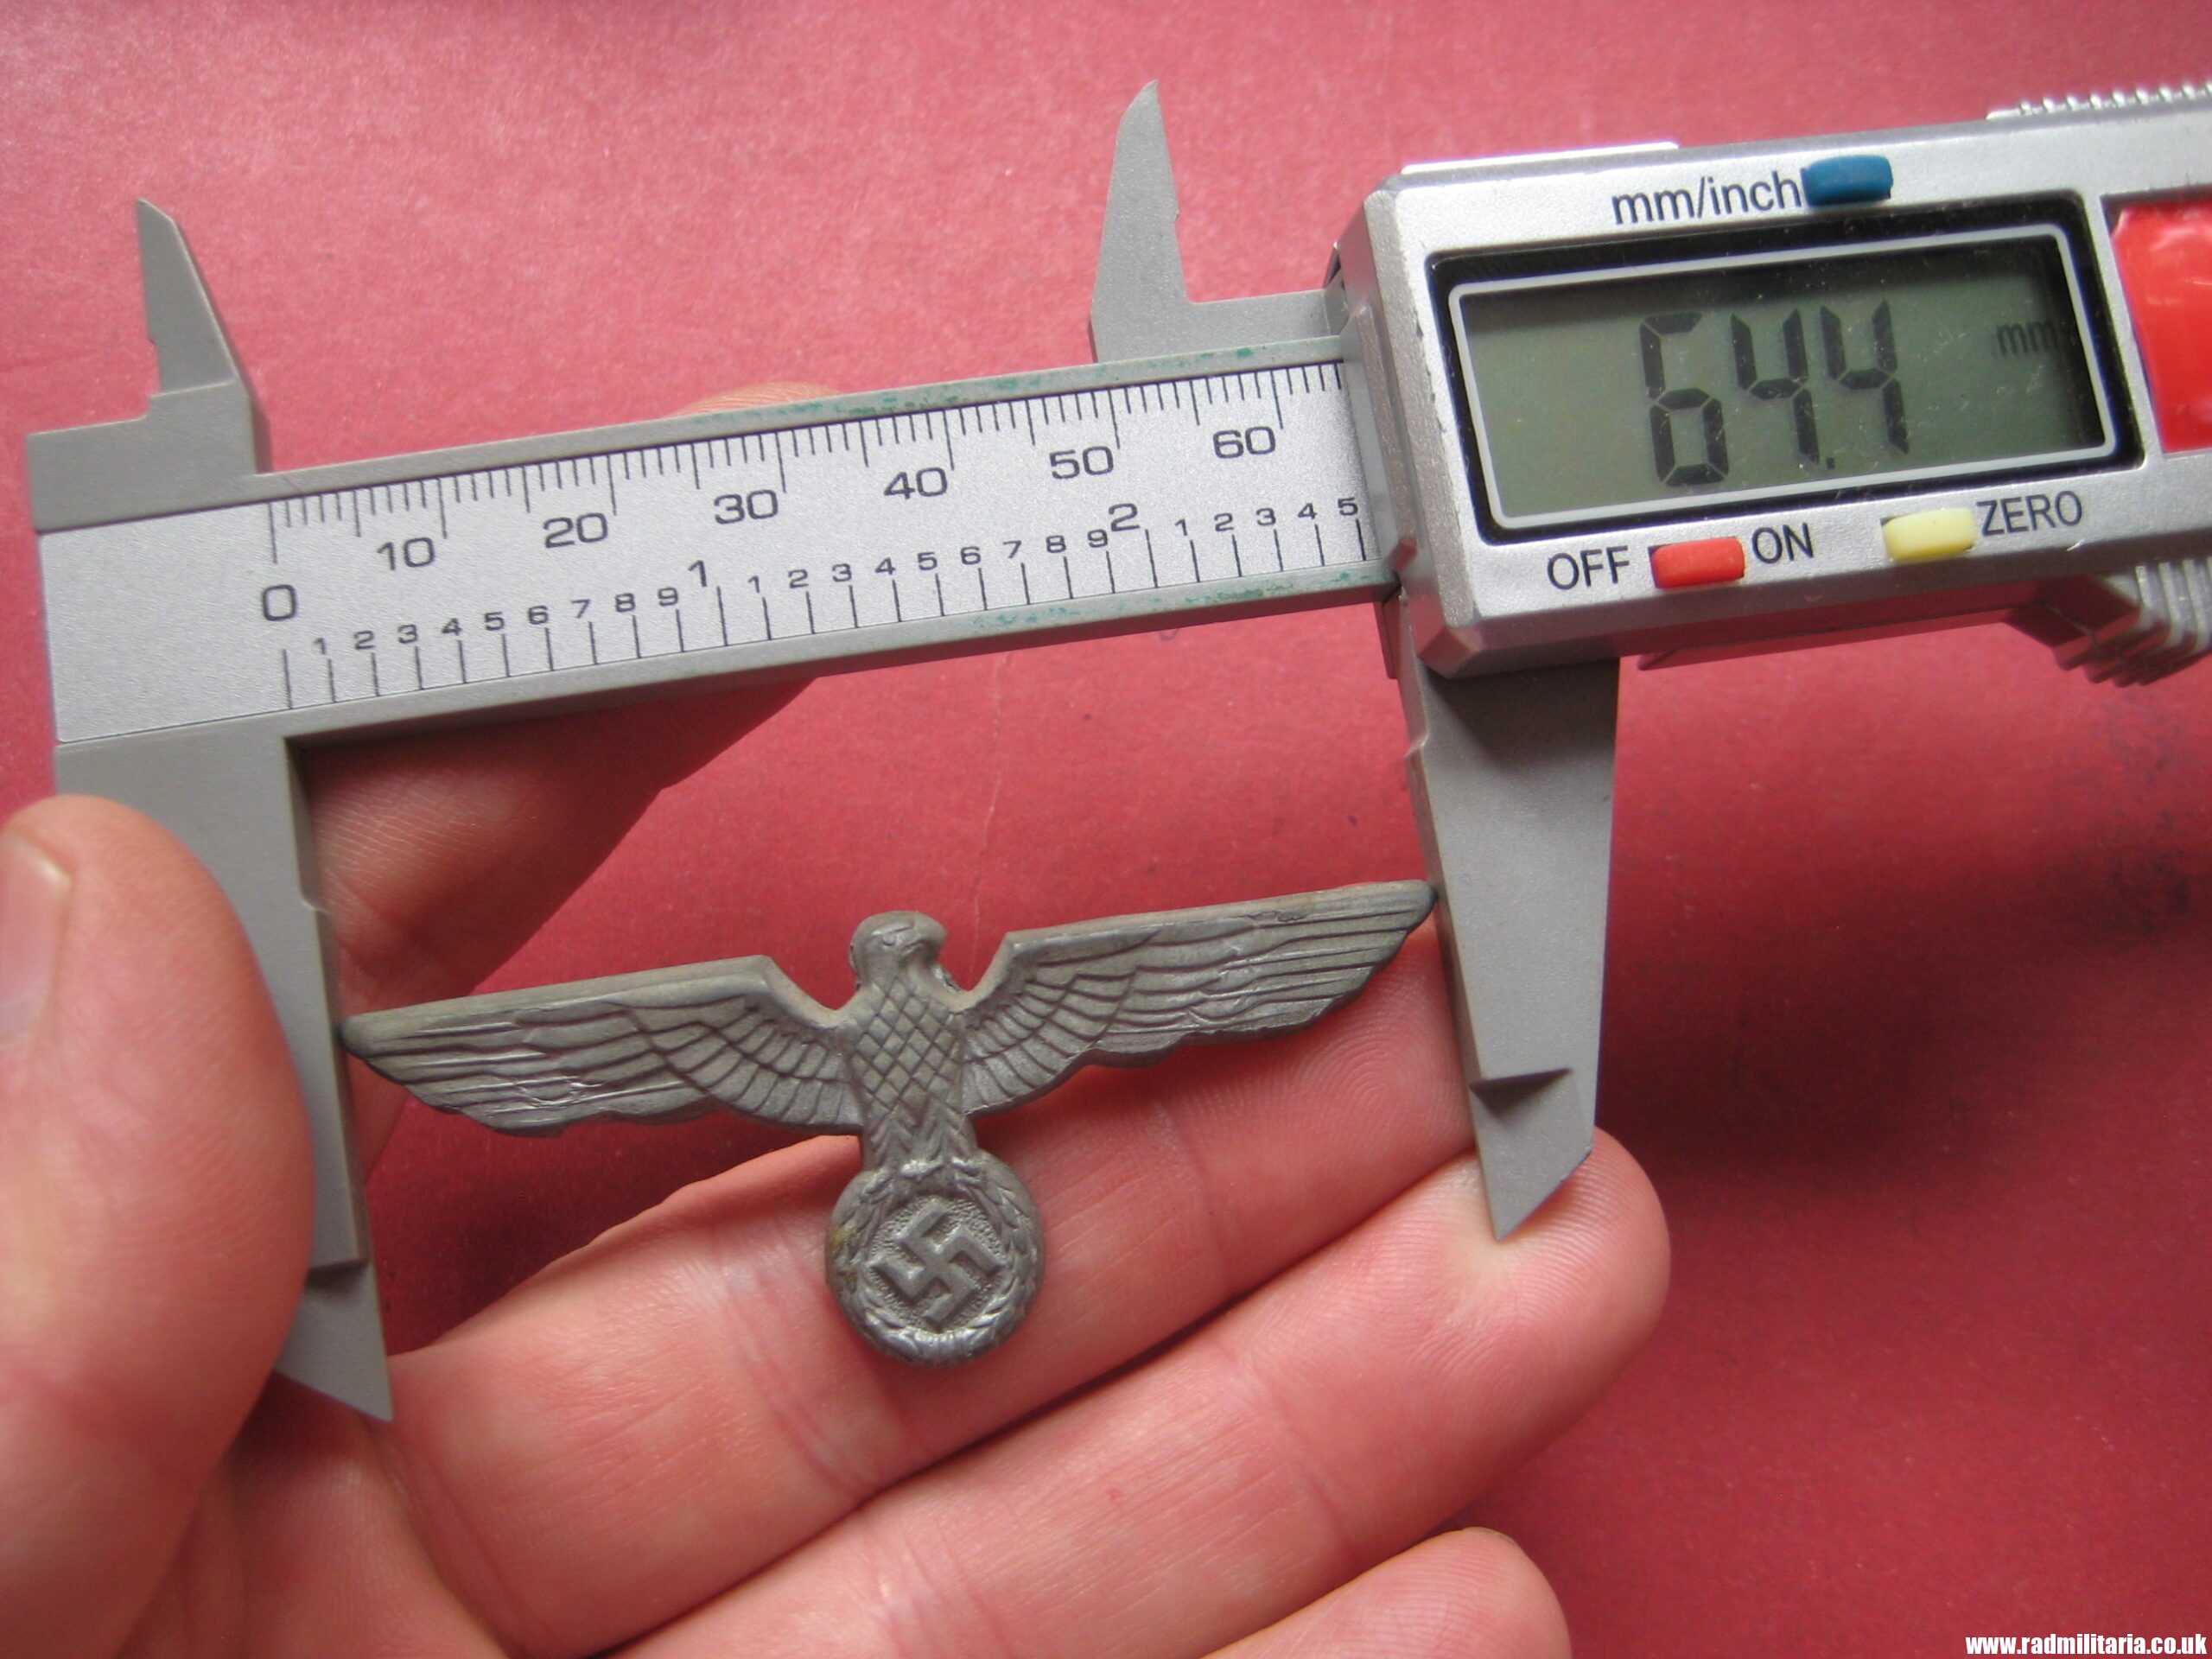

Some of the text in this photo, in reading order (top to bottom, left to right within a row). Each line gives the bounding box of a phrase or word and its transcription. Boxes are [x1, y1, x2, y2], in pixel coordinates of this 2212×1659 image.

[1612, 171, 1801, 225] mm/inch
[1640, 300, 2059, 487] 64.4 mm
[262, 427, 1276, 622] 0 10 20 30 40 50 60
[1977, 490, 2083, 537] ZERO
[1548, 546, 1630, 590] OFF
[1751, 523, 1813, 563] ON
[314, 498, 1357, 654] 1 2 3 4 5 6 7 8 9 1 1 2 3 4 5 6 7 8 9 2 1 2 3 4 5
